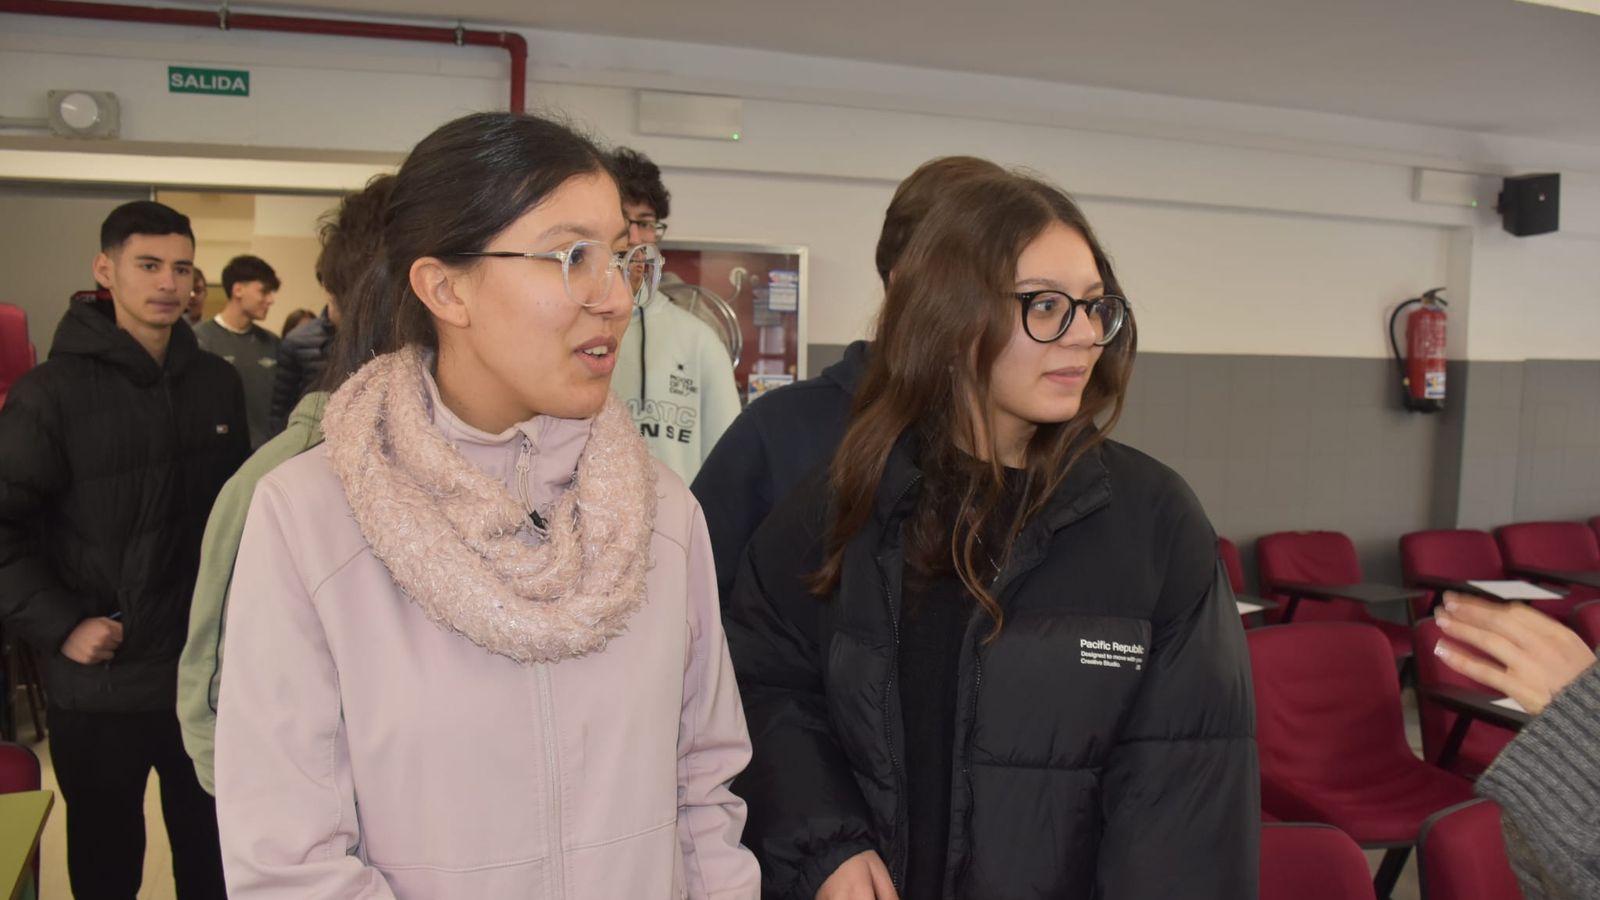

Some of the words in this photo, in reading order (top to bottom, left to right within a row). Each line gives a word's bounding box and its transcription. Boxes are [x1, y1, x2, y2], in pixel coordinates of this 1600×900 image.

[171, 72, 246, 91] SALIDA
[1080, 639, 1111, 651] Pacific
[1112, 642, 1145, 654] Republic
[1080, 650, 1106, 659] Designed
[1112, 654, 1127, 662] move
[1080, 658, 1103, 666] Creative
